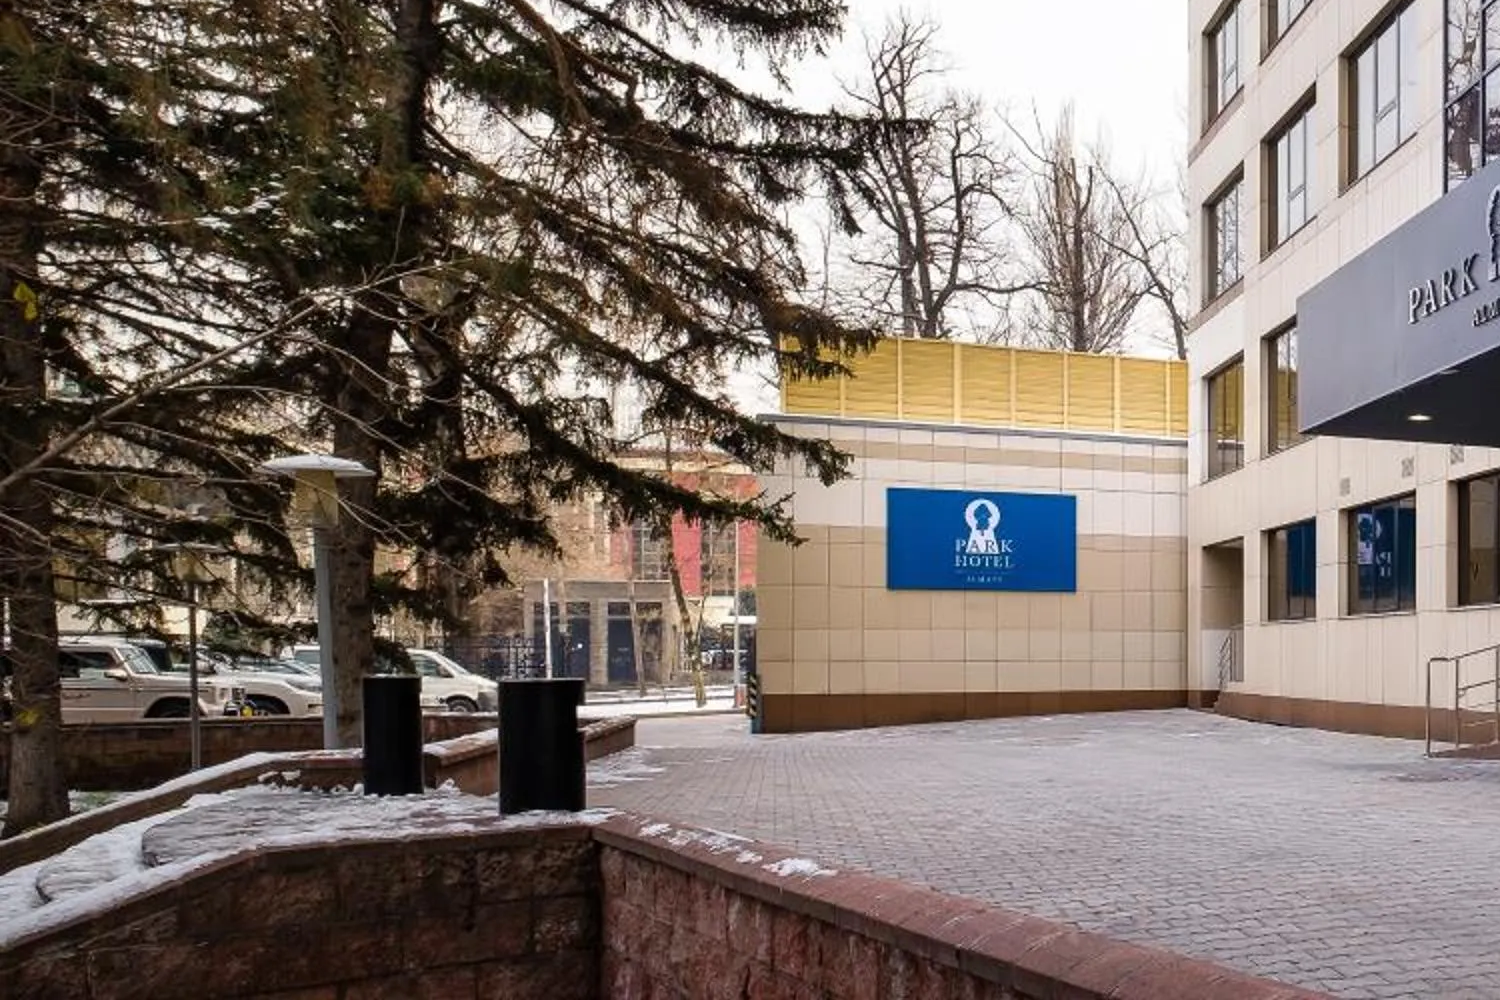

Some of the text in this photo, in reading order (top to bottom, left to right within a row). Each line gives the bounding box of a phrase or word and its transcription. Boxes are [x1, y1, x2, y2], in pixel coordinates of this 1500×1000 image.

[1407, 253, 1479, 325] PARK
[955, 539, 1014, 553] PARK
[955, 555, 1015, 568] HOTEL
